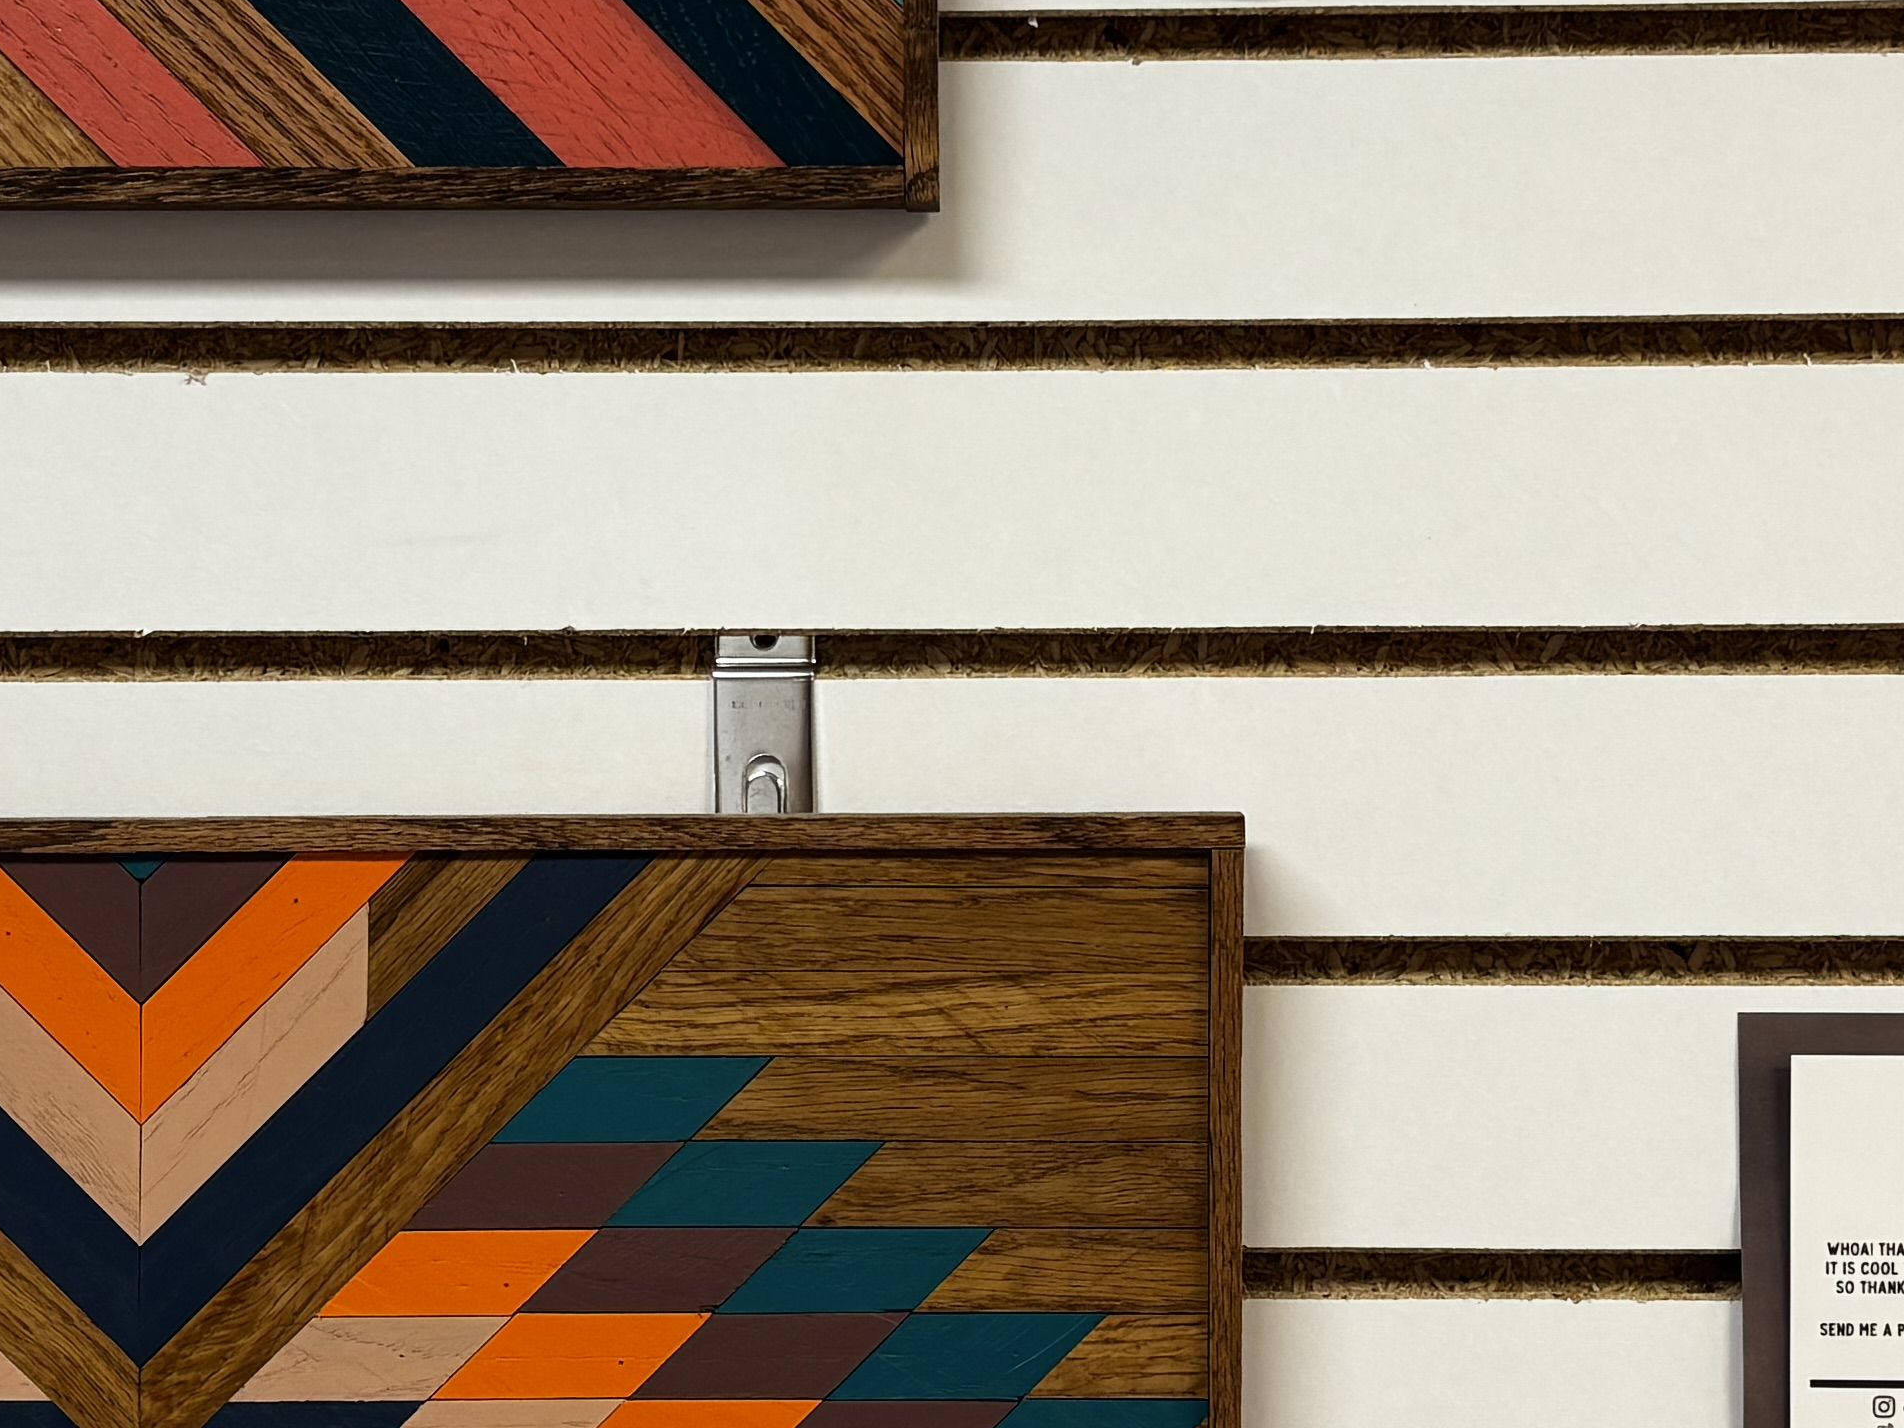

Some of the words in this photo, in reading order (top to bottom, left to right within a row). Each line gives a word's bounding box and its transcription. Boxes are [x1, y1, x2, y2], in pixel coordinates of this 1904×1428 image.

[1827, 1241, 1873, 1256] WHOA!
[1826, 1261, 1837, 1275] IT
[1843, 1261, 1855, 1275] IS
[1861, 1261, 1898, 1275] COOL
[1836, 1280, 1854, 1294] SO
[1860, 1280, 1904, 1294] THANK
[1820, 1322, 1854, 1336] SEND
[1859, 1322, 1877, 1336] ME
[1883, 1322, 1892, 1336] A
